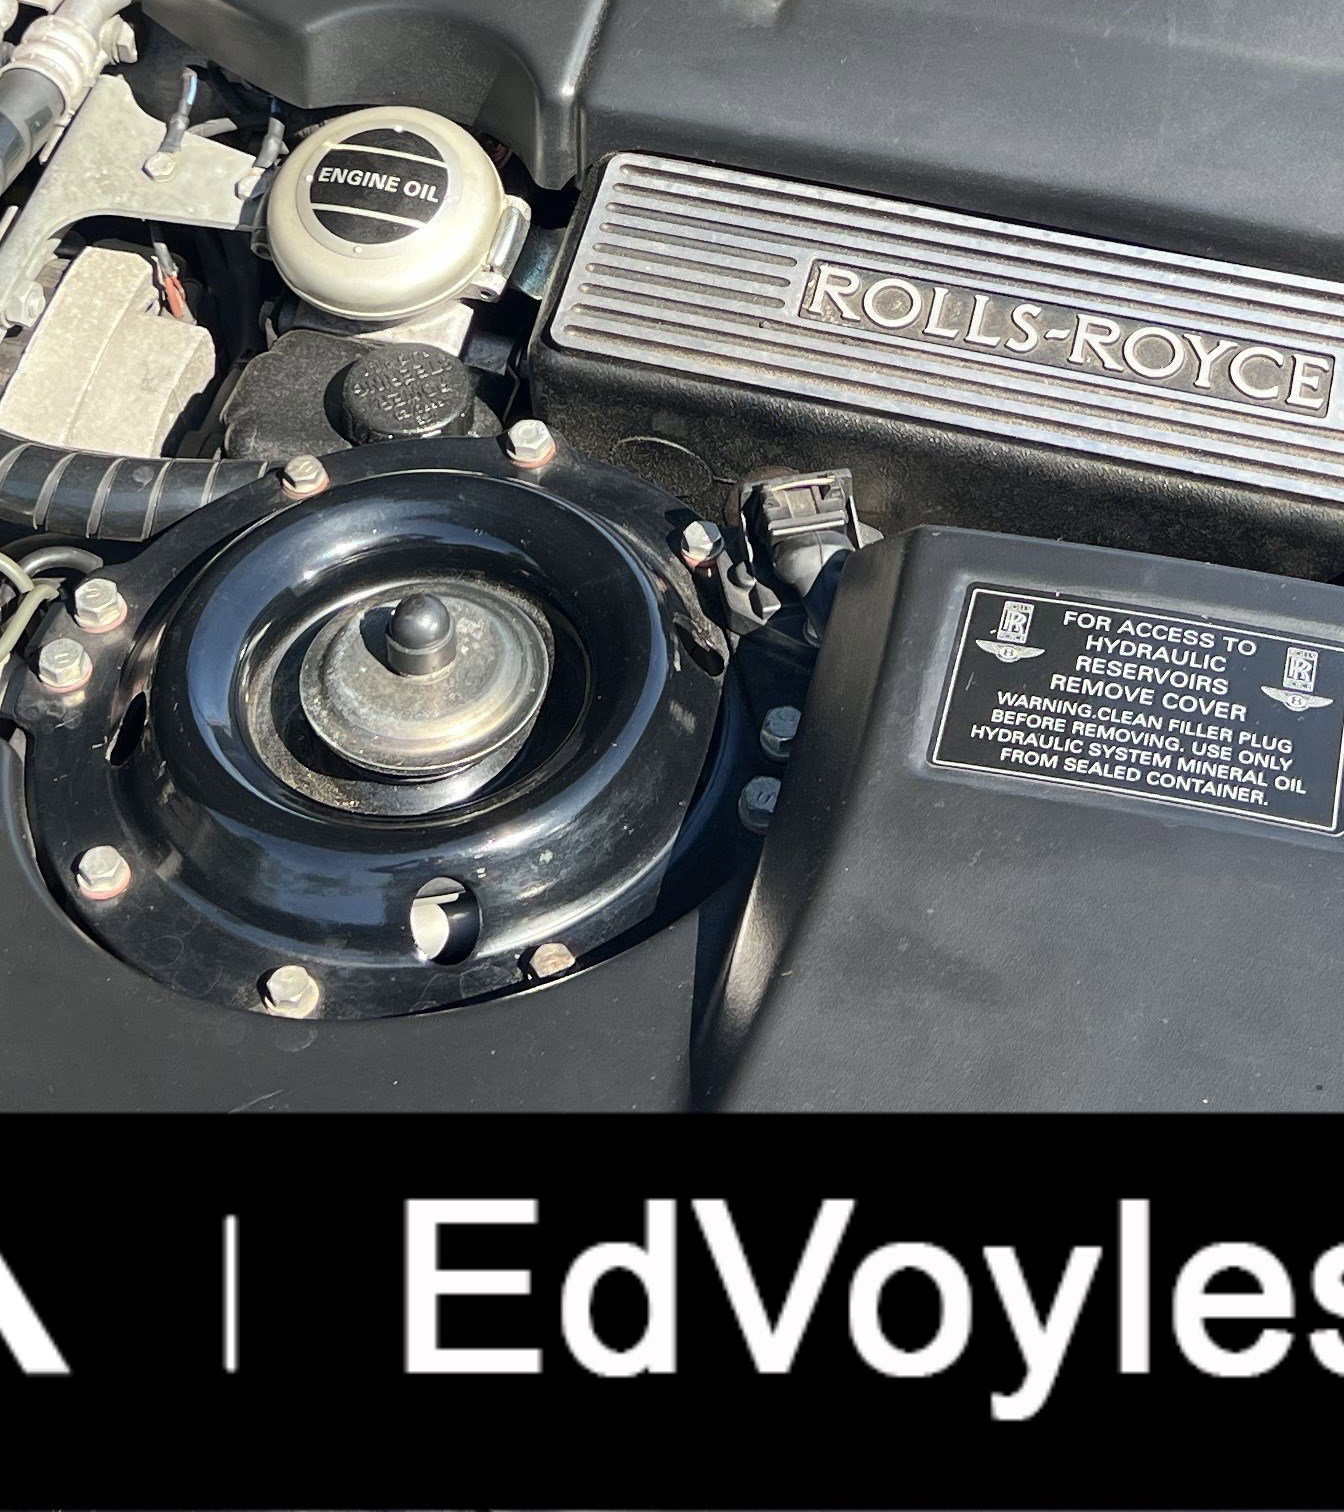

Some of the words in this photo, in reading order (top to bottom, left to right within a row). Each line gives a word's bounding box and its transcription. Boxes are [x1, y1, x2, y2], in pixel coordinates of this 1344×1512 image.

[317, 167, 401, 193] ENGINE
[403, 180, 439, 203] OIL
[807, 265, 1332, 409] ROLLS-ROYCE
[1063, 610, 1112, 632] FOR
[1117, 620, 1215, 648] ACCESS
[1222, 636, 1256, 656] TO
[1085, 634, 1227, 672] HYDRAULIC
[1050, 673, 1155, 706] REMOVE
[1162, 692, 1247, 722] COVER
[1075, 655, 1229, 695] RESERVOIRS
[970, 724, 1084, 754] HYDRAULIC
[1088, 742, 1172, 769] SYSTEM
[1177, 756, 1268, 787] MINERAL
[1274, 776, 1307, 795] OIL
[991, 709, 1066, 733] BEFORE
[1071, 721, 1185, 753] REMOVING.
[1191, 741, 1233, 761] USE
[1238, 750, 1293, 772] ONLY
[1168, 718, 1233, 742] FILLER
[1238, 731, 1292, 754] PLUG
[1000, 748, 1058, 769] FROM
[1063, 758, 1141, 782] SEALED
[1146, 771, 1269, 806] CONTAINER.
